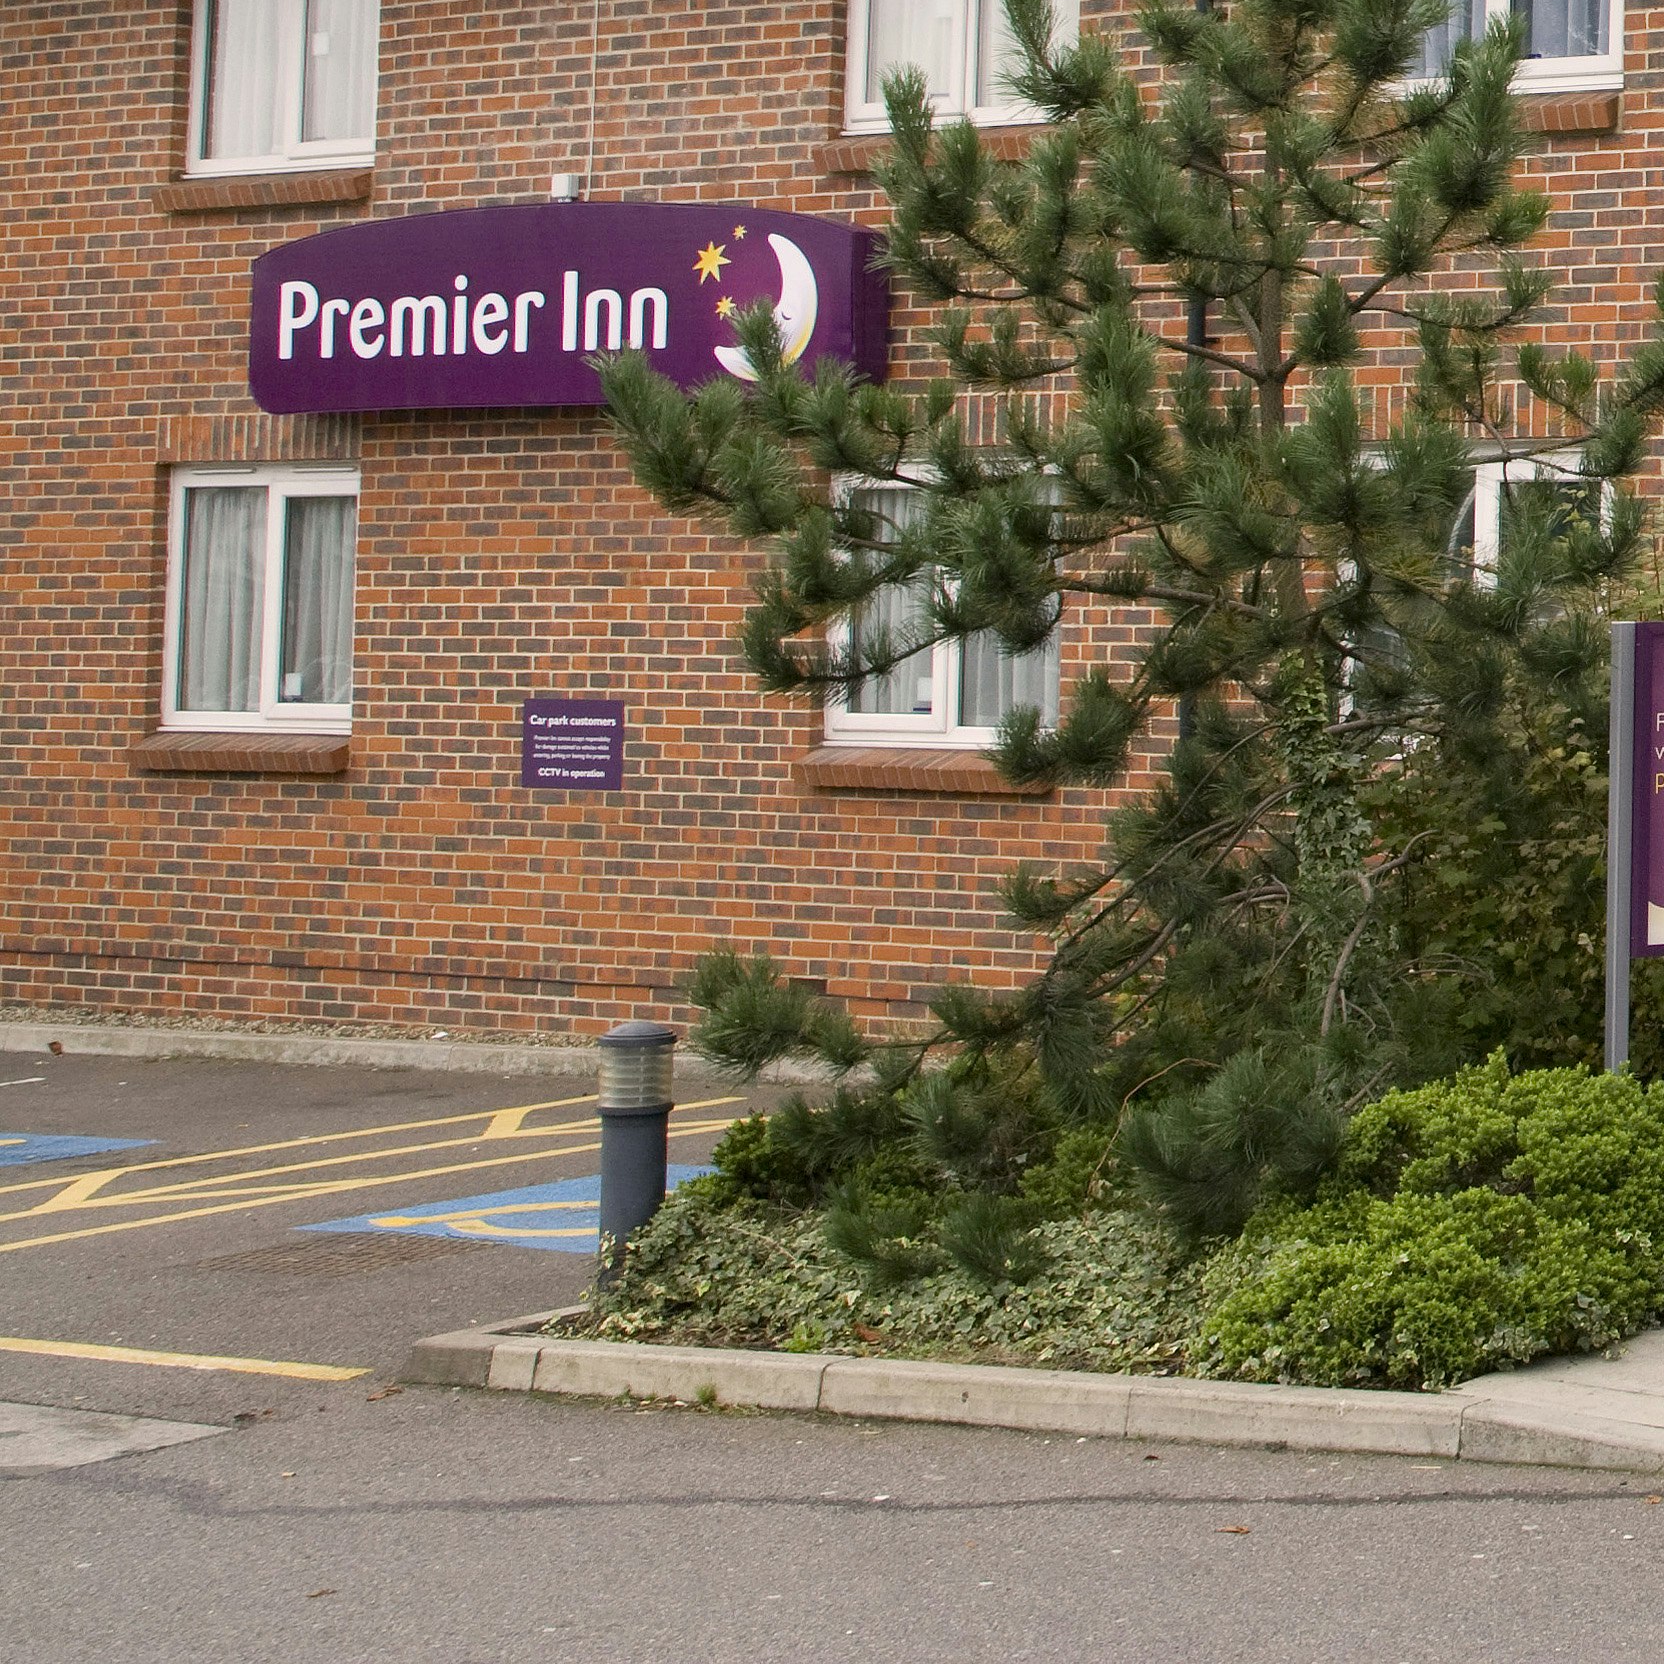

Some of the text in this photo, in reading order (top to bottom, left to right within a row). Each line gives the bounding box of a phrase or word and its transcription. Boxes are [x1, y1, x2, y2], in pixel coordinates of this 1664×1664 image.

[278, 270, 669, 360] Premier Inn
[529, 714, 616, 728] Car park customers
[538, 767, 606, 779] CCTV in operation
